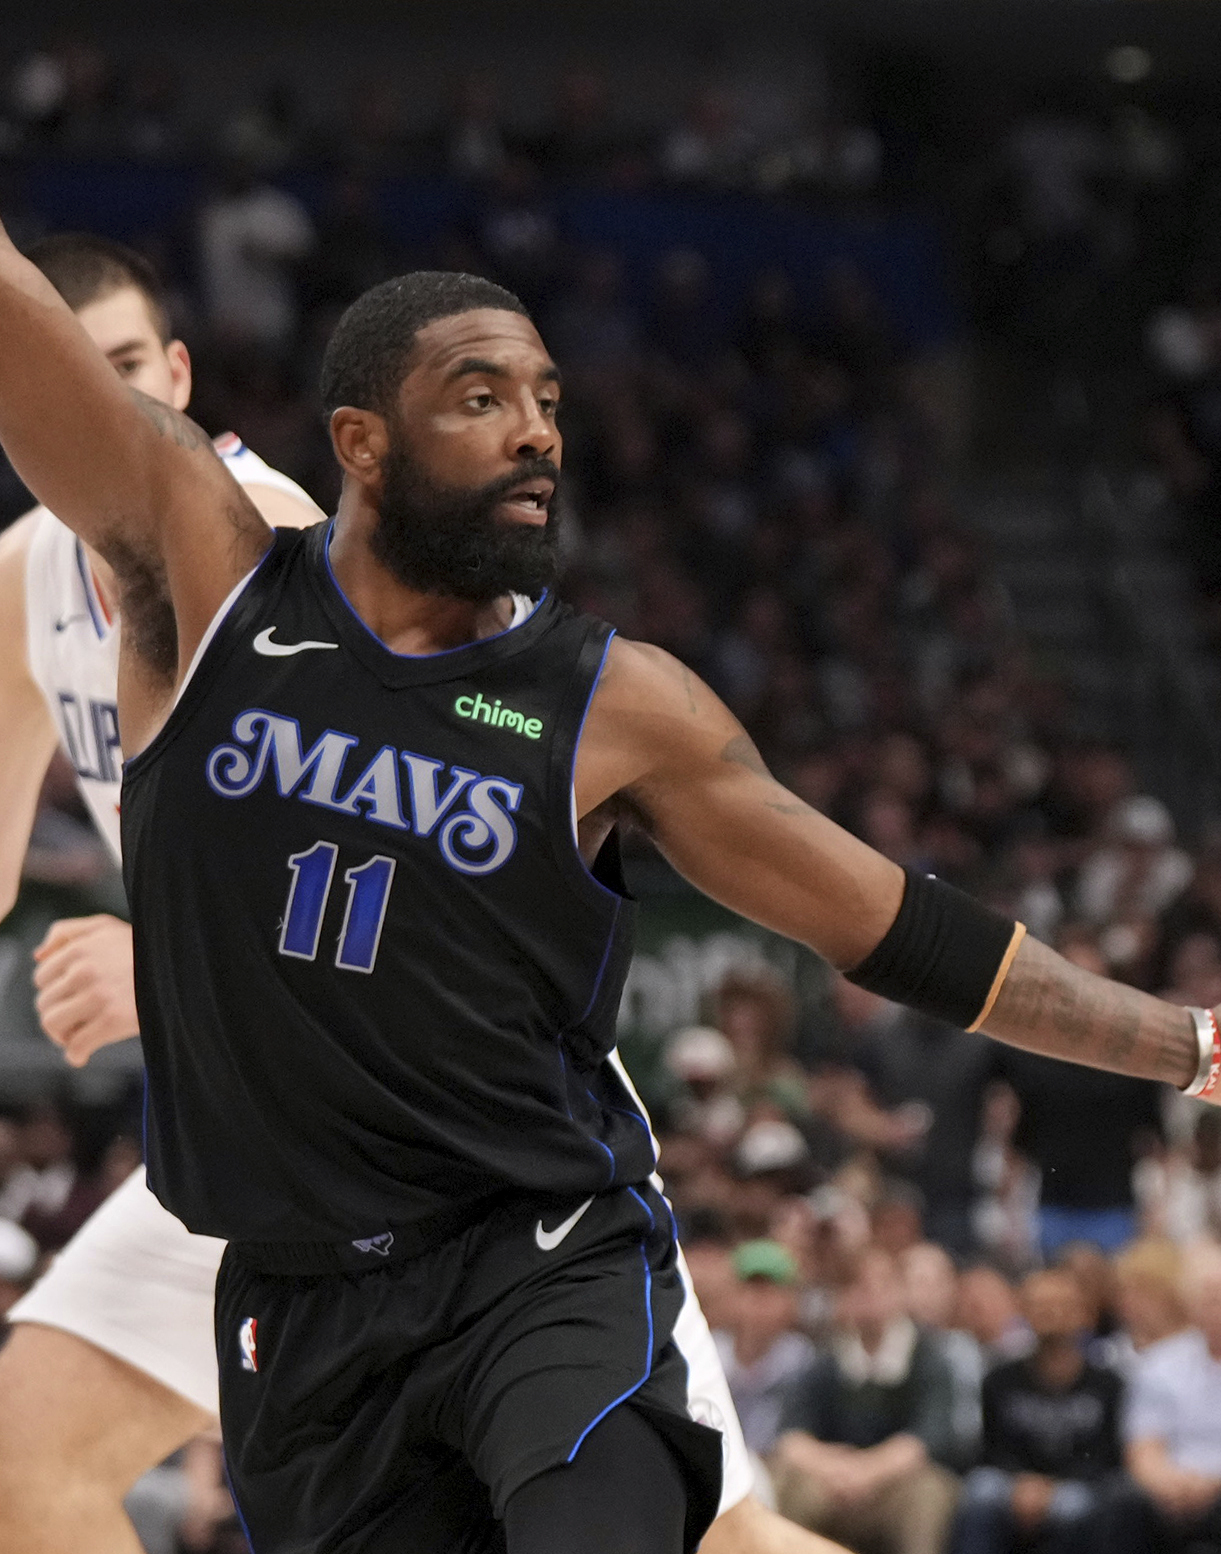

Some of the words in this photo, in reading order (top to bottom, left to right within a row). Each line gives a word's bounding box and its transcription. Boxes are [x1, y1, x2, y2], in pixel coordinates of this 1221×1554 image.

[455, 693, 544, 740] chime
[206, 708, 524, 876] MAVS
[279, 840, 396, 974] 11
